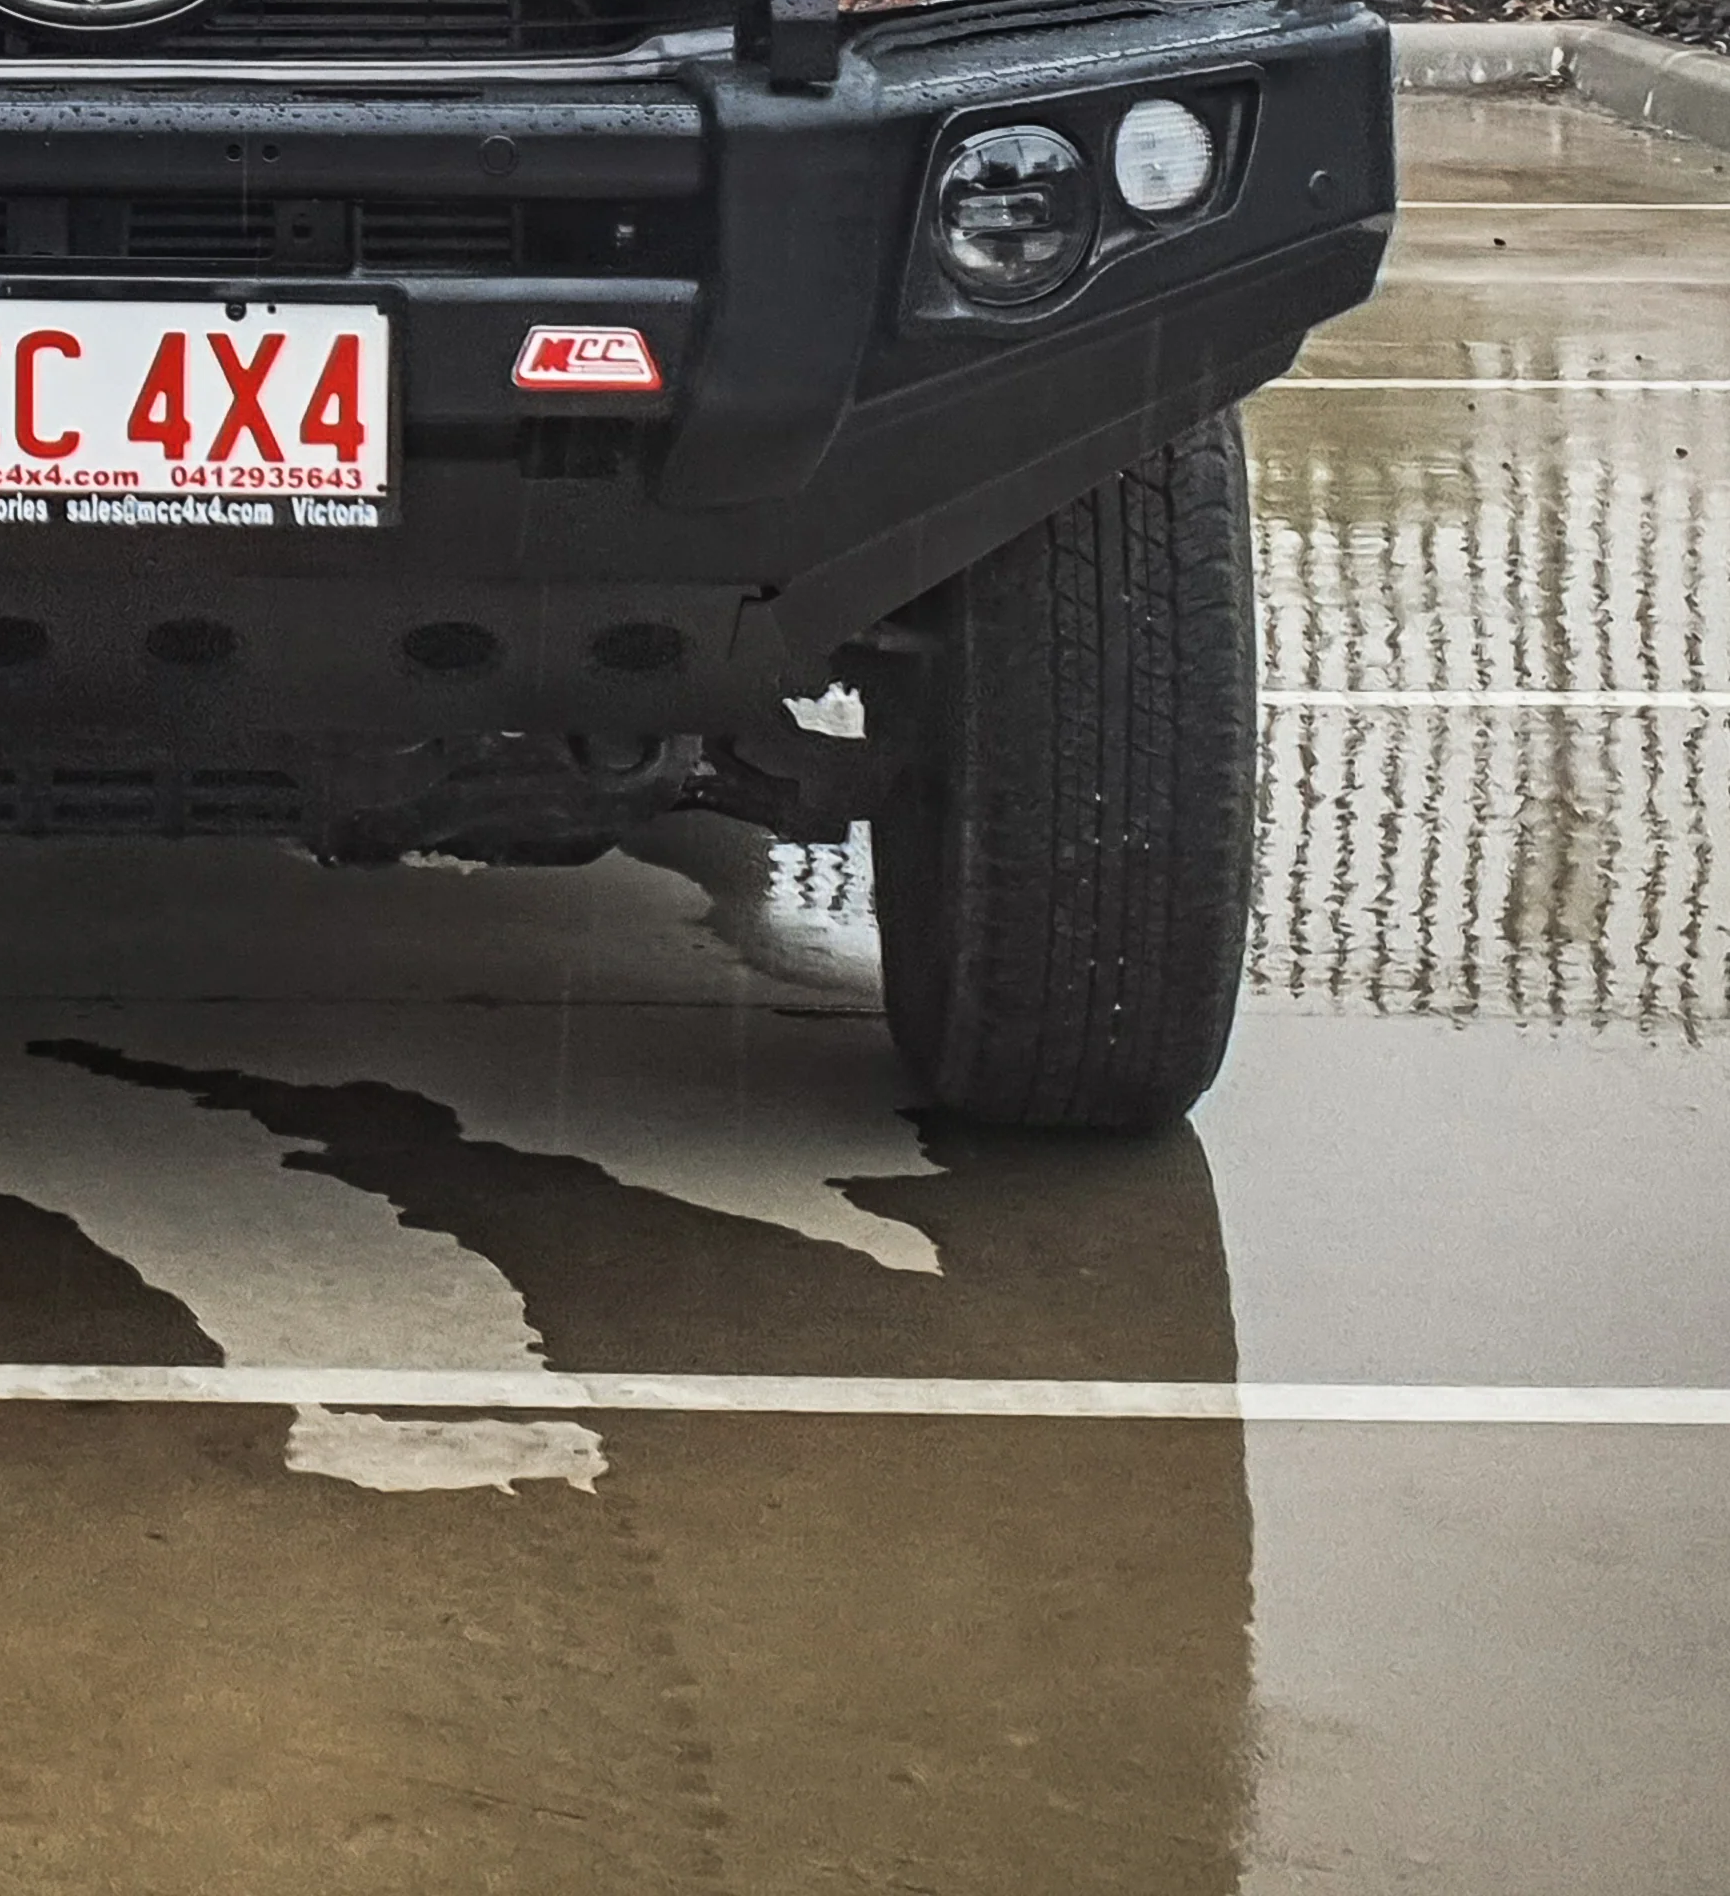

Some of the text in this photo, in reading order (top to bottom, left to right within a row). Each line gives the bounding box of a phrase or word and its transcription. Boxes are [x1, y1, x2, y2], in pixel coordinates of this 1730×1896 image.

[530, 337, 639, 372] MCC
[127, 332, 367, 464] 4X4
[171, 466, 363, 490] 0412935643
[66, 494, 274, 526] sales@mcc4x4.com
[291, 496, 379, 528] Victoria
